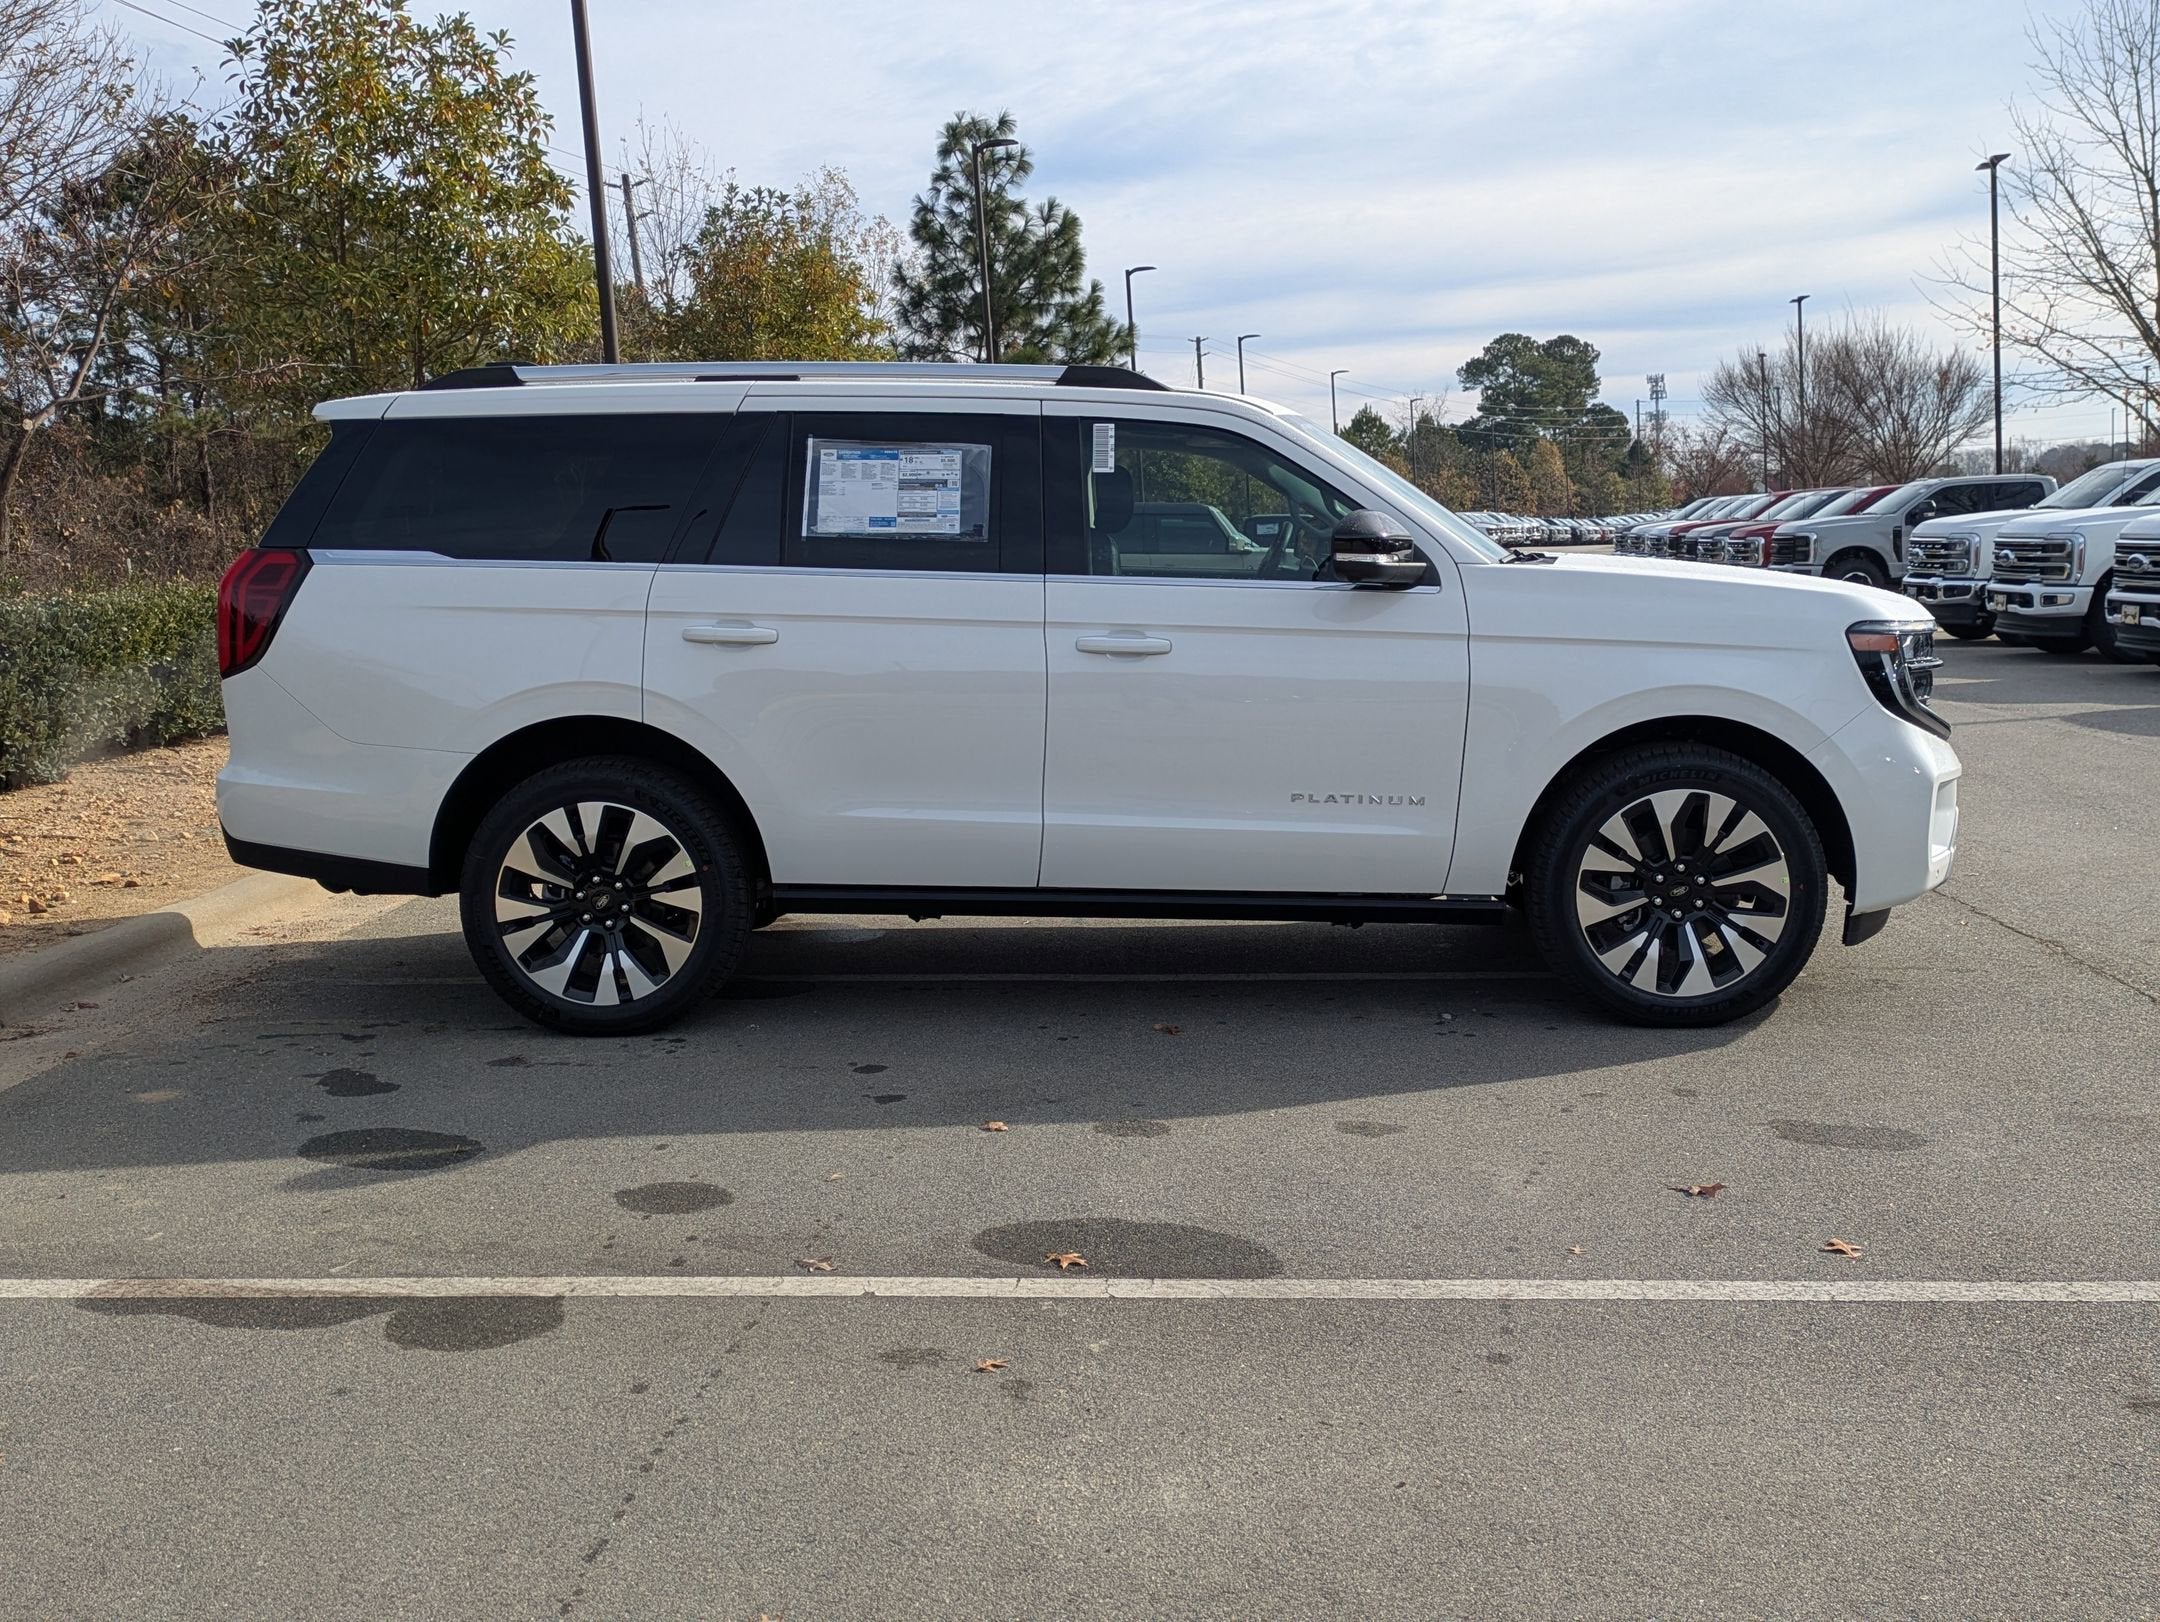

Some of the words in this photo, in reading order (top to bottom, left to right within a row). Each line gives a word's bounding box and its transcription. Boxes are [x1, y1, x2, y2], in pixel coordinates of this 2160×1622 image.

[904, 456, 914, 464] 18
[1637, 768, 1719, 786] MICHELIN
[1290, 792, 1426, 807] PLATINUM
